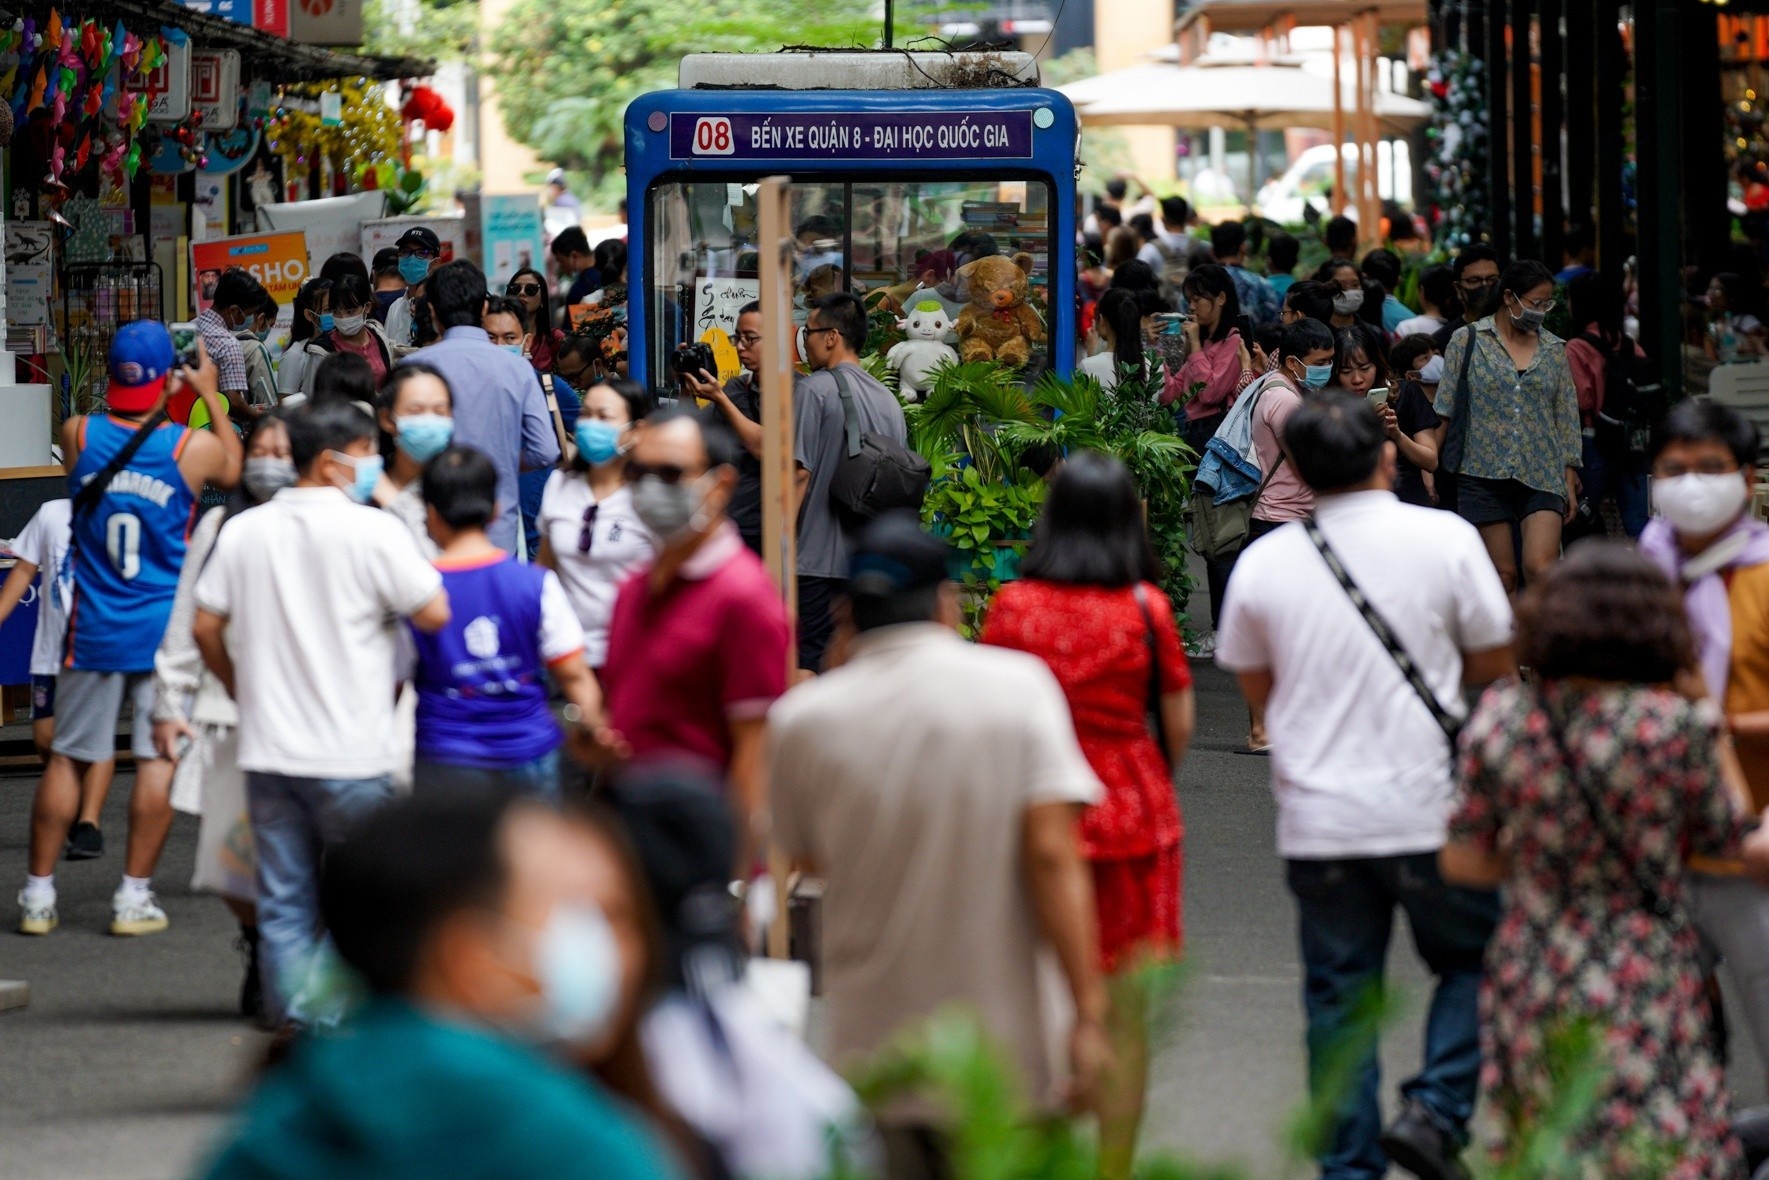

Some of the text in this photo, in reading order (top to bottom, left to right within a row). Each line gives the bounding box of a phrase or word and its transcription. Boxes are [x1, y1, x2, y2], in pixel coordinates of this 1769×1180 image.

[697, 121, 730, 151] 08
[752, 117, 781, 149] BẾN
[785, 126, 804, 149] XE
[808, 121, 849, 153] QUẬN
[853, 126, 861, 149] 8
[873, 125, 898, 153] ĐẠI
[902, 125, 934, 153] HỌC
[938, 116, 980, 149] QUỐC
[983, 125, 1009, 148] GIA
[246, 258, 304, 286] SHO
[106, 512, 141, 581] 0
